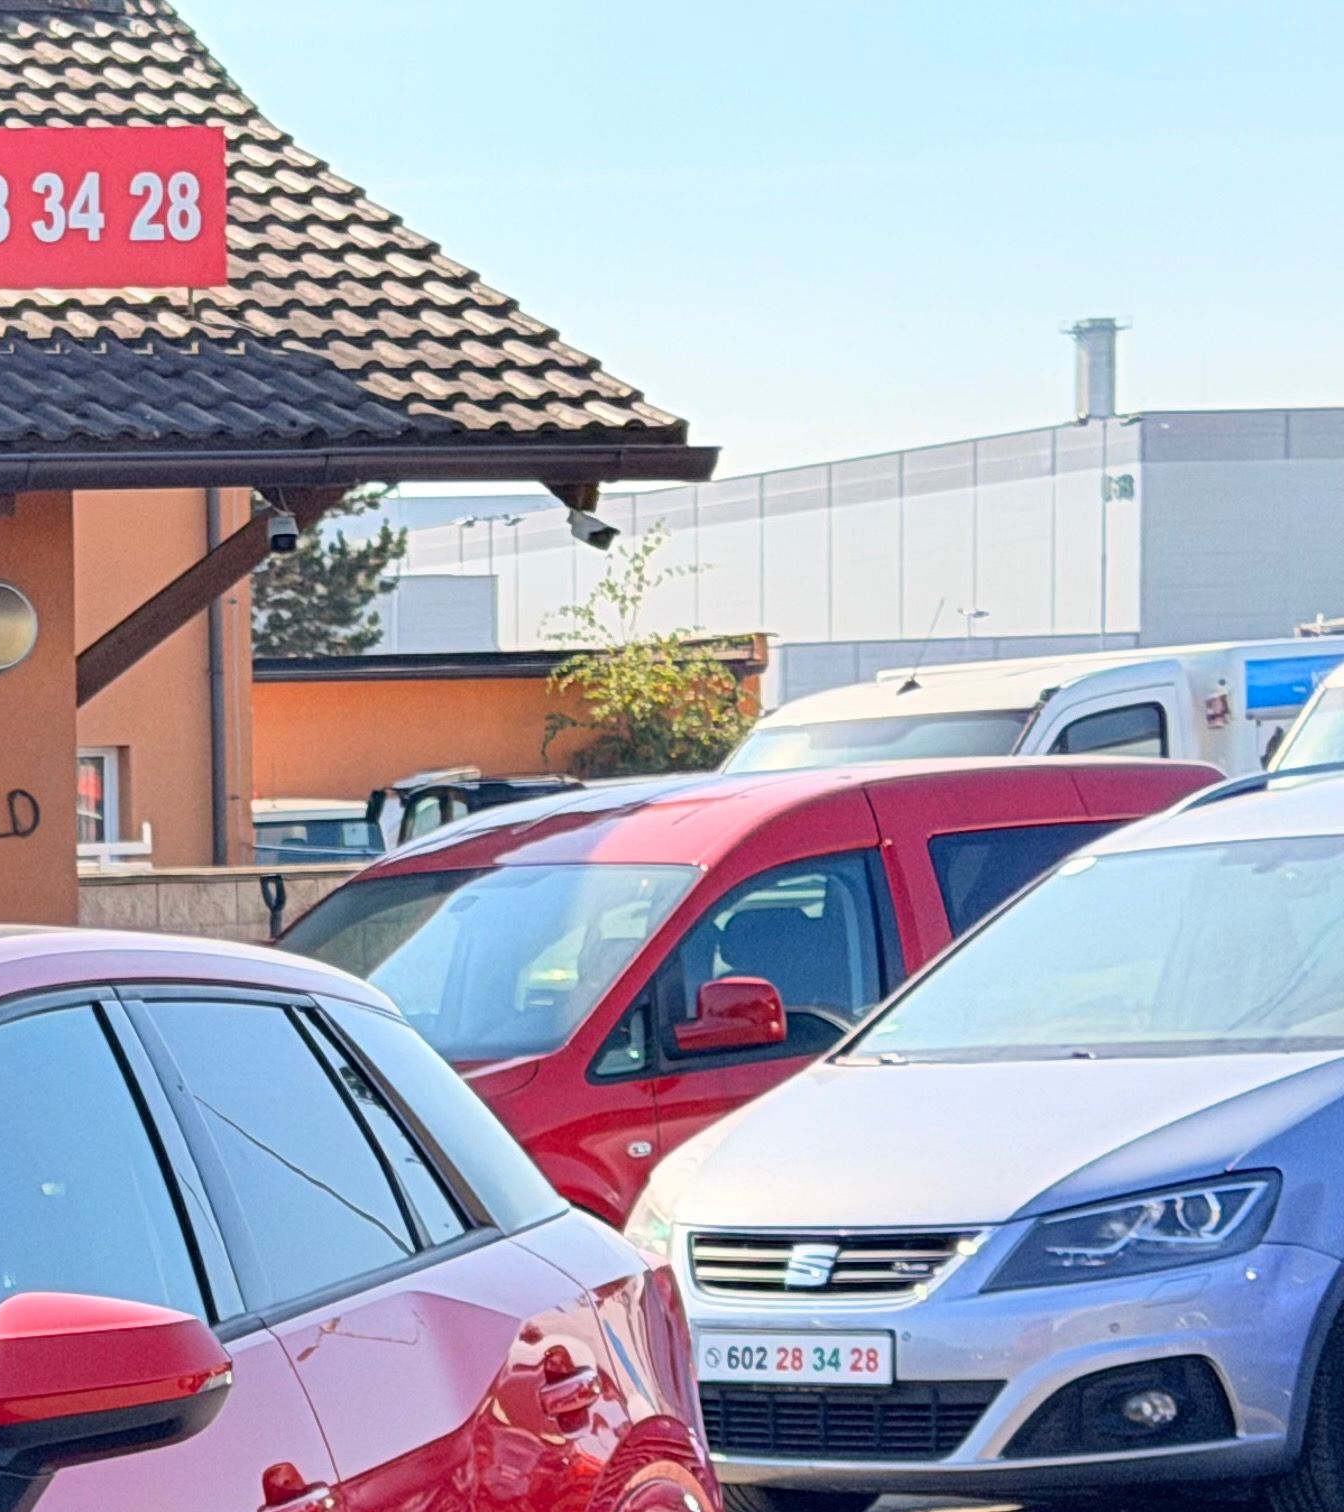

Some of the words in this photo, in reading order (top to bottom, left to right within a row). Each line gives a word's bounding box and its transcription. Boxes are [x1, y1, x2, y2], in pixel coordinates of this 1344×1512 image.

[30, 171, 105, 243] 34
[128, 170, 202, 242] 28
[726, 1345, 769, 1371] 602
[775, 1346, 804, 1372] 28
[811, 1346, 842, 1372] 34
[848, 1347, 880, 1373] 28
